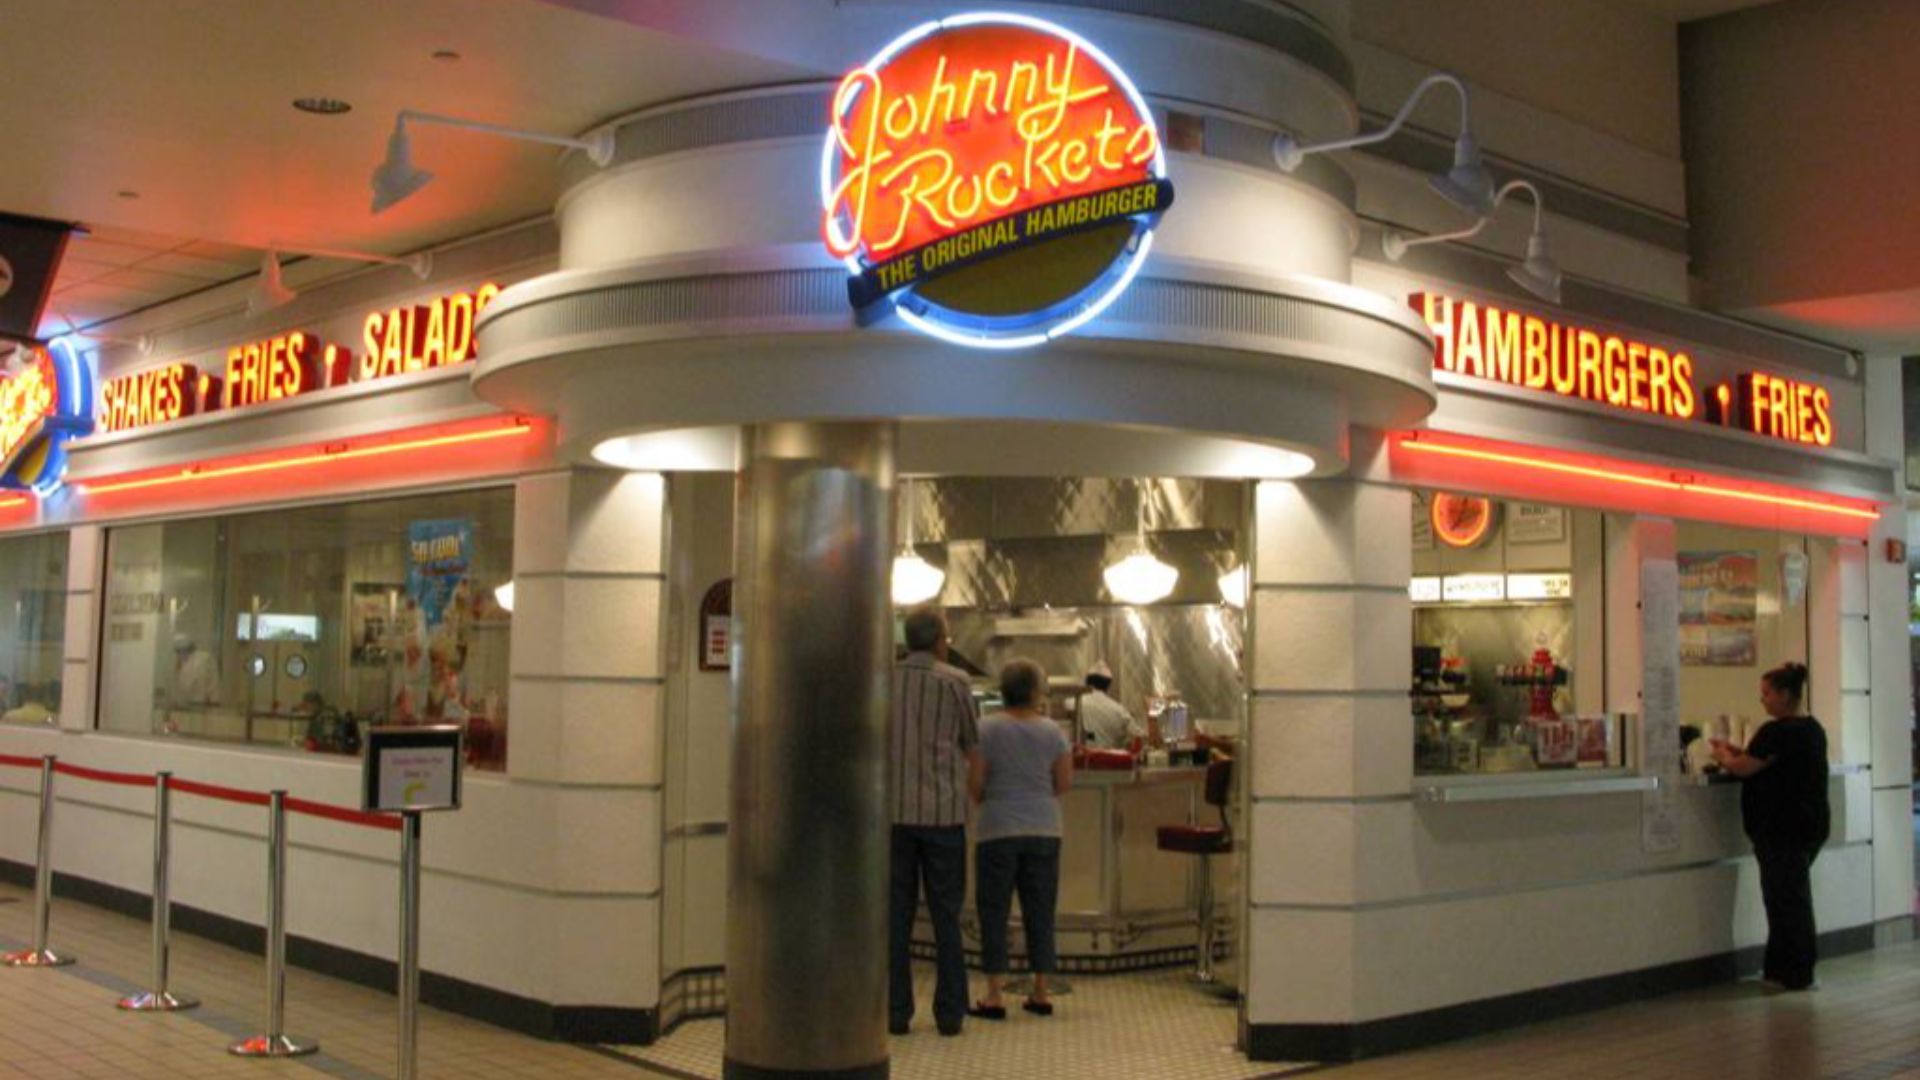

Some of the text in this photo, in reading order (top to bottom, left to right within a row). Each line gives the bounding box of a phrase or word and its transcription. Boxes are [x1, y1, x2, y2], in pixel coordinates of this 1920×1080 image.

[826, 40, 1110, 252] Johnny
[871, 108, 1159, 251] Rockets
[877, 182, 1159, 291] THE ORIGINAL HAMBURGER
[100, 364, 184, 432] SHAKES
[226, 331, 307, 408] FRIES
[1424, 291, 1832, 447] HAMBURGERS FRIES
